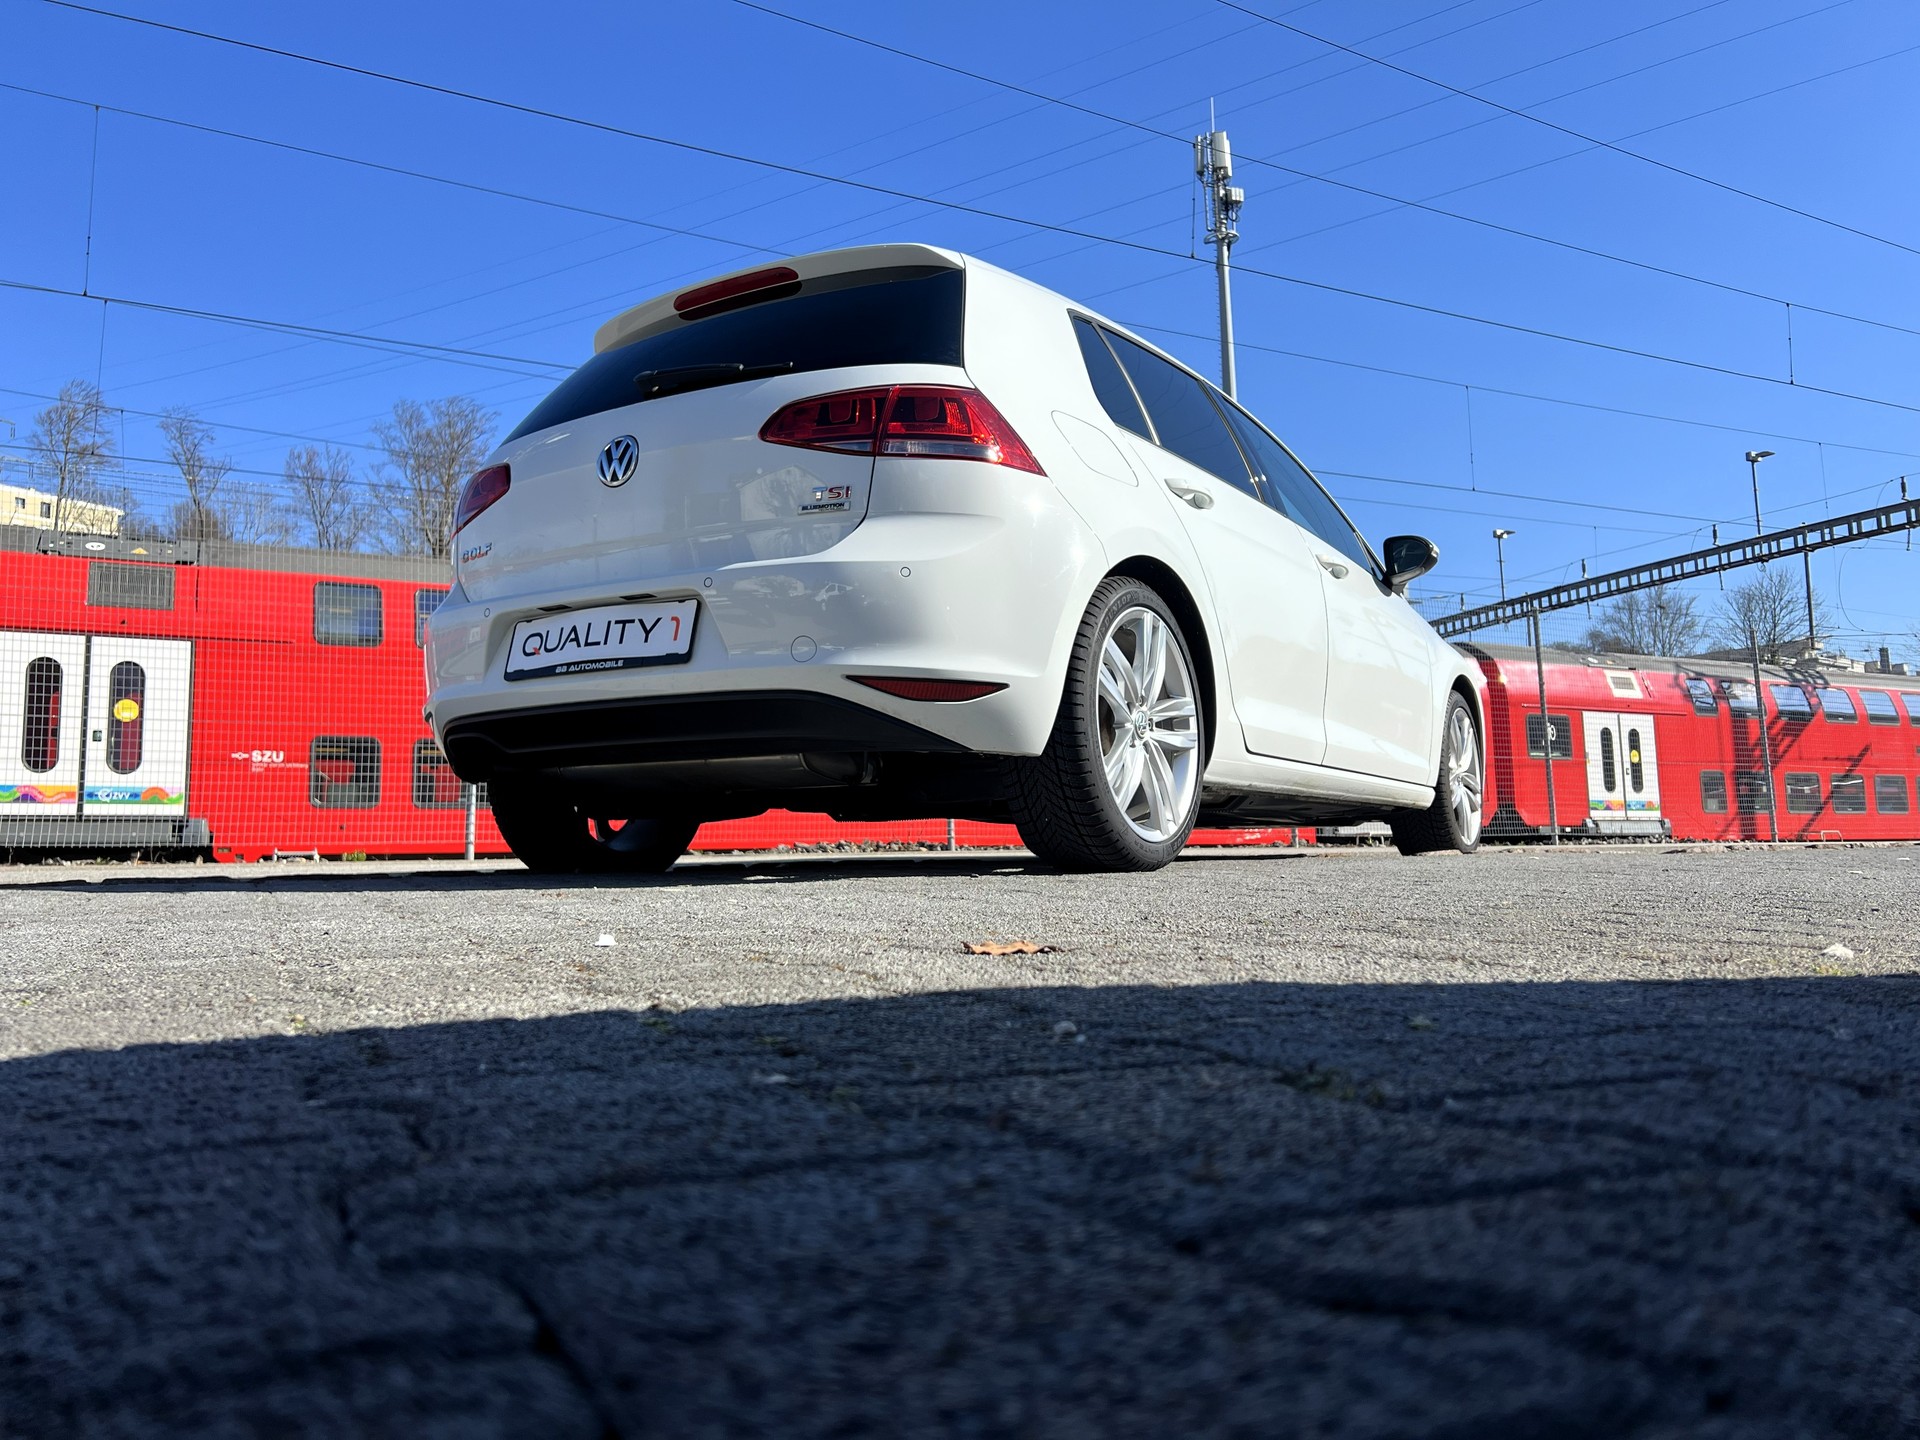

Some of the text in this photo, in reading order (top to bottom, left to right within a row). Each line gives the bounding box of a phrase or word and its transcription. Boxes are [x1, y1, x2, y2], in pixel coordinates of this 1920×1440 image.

[597, 435, 639, 488] VW
[812, 486, 852, 501] TSI
[462, 542, 493, 564] GOLF
[522, 616, 681, 657] QUALITY 1
[568, 660, 624, 672] AUTOMOBILE
[251, 750, 285, 762] SZU
